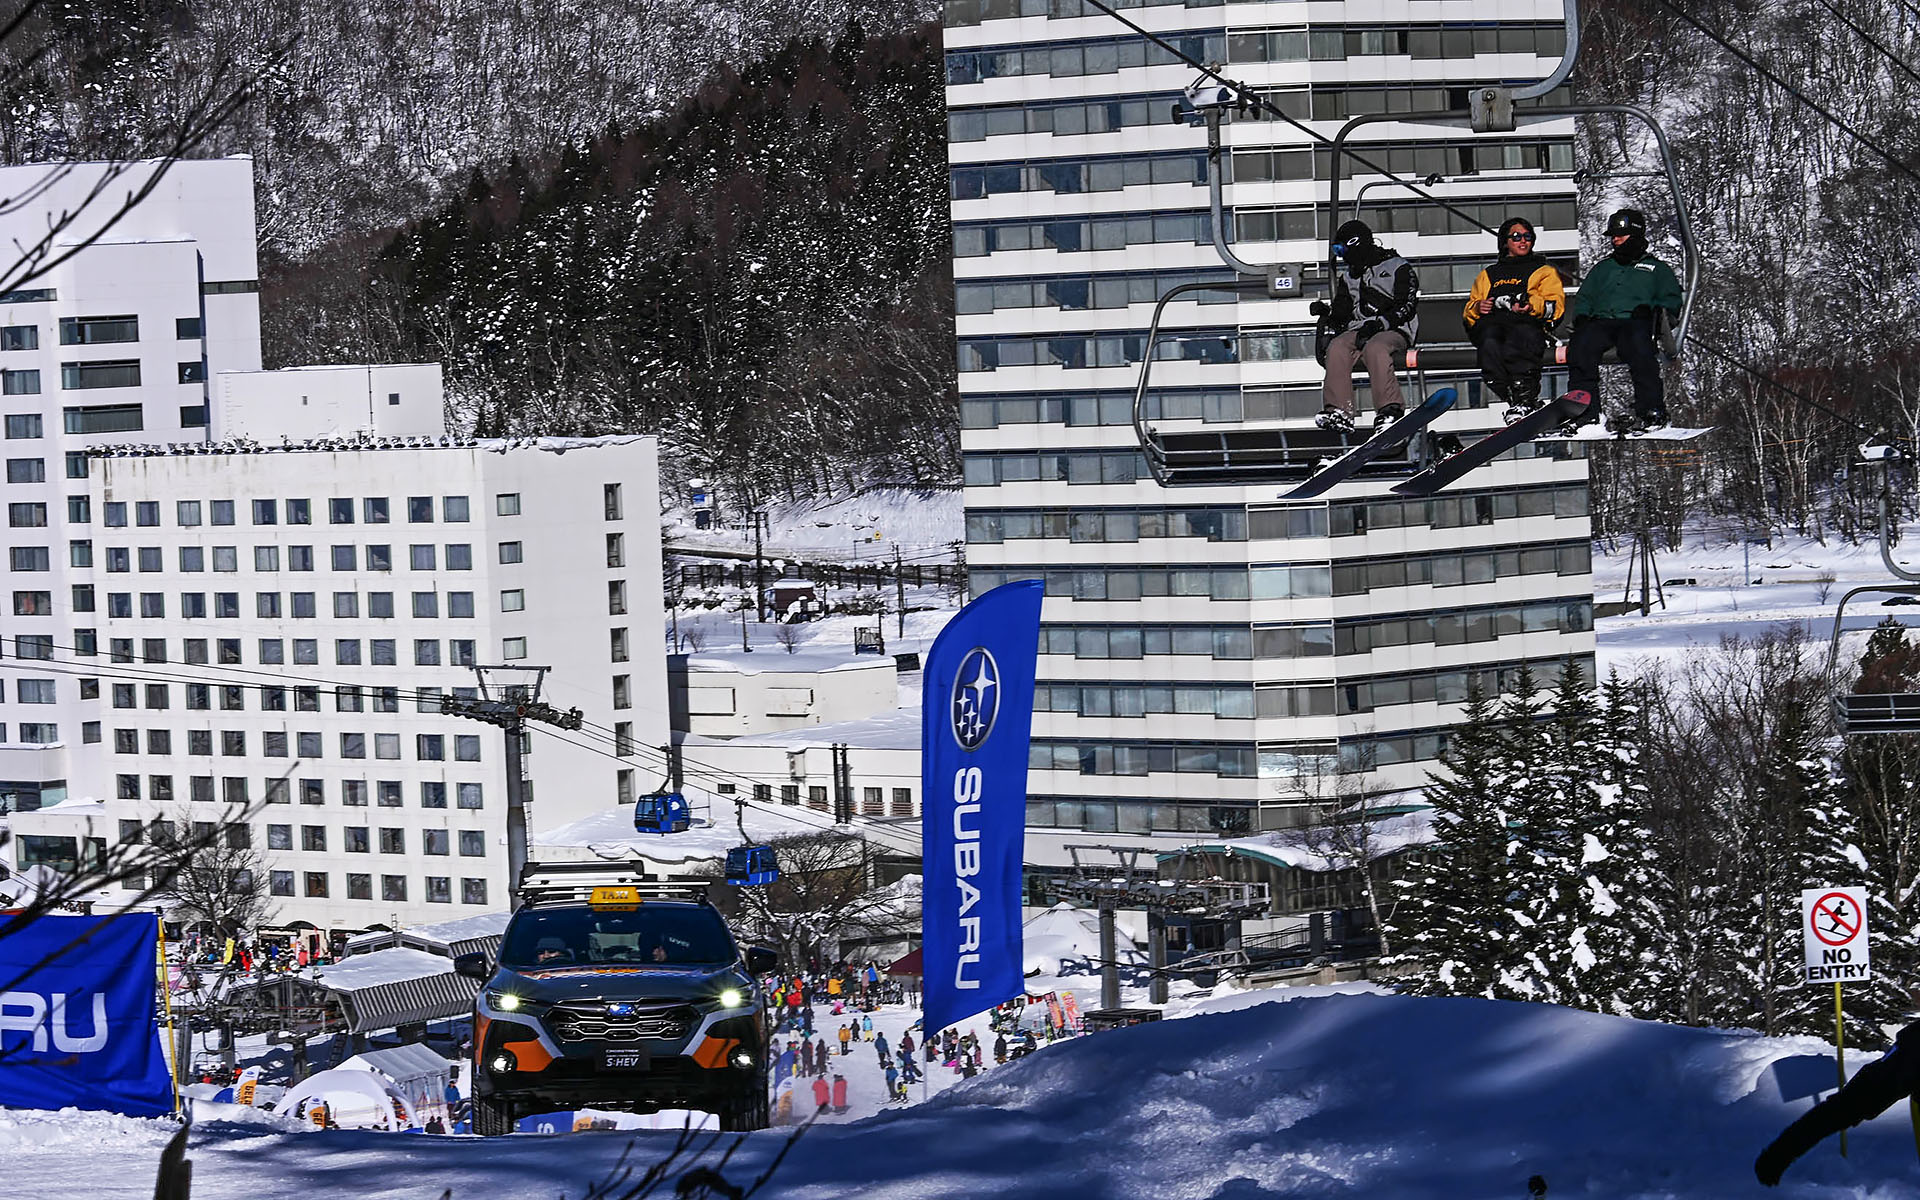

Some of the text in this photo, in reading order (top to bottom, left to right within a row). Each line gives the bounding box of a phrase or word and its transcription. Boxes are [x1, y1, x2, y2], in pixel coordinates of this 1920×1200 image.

[1277, 278, 1291, 287] 46
[953, 766, 983, 990] SUBARU
[600, 890, 629, 900] TAXI
[1822, 948, 1852, 964] NO
[1808, 963, 1868, 980] ENTRY
[0, 991, 109, 1053] RU
